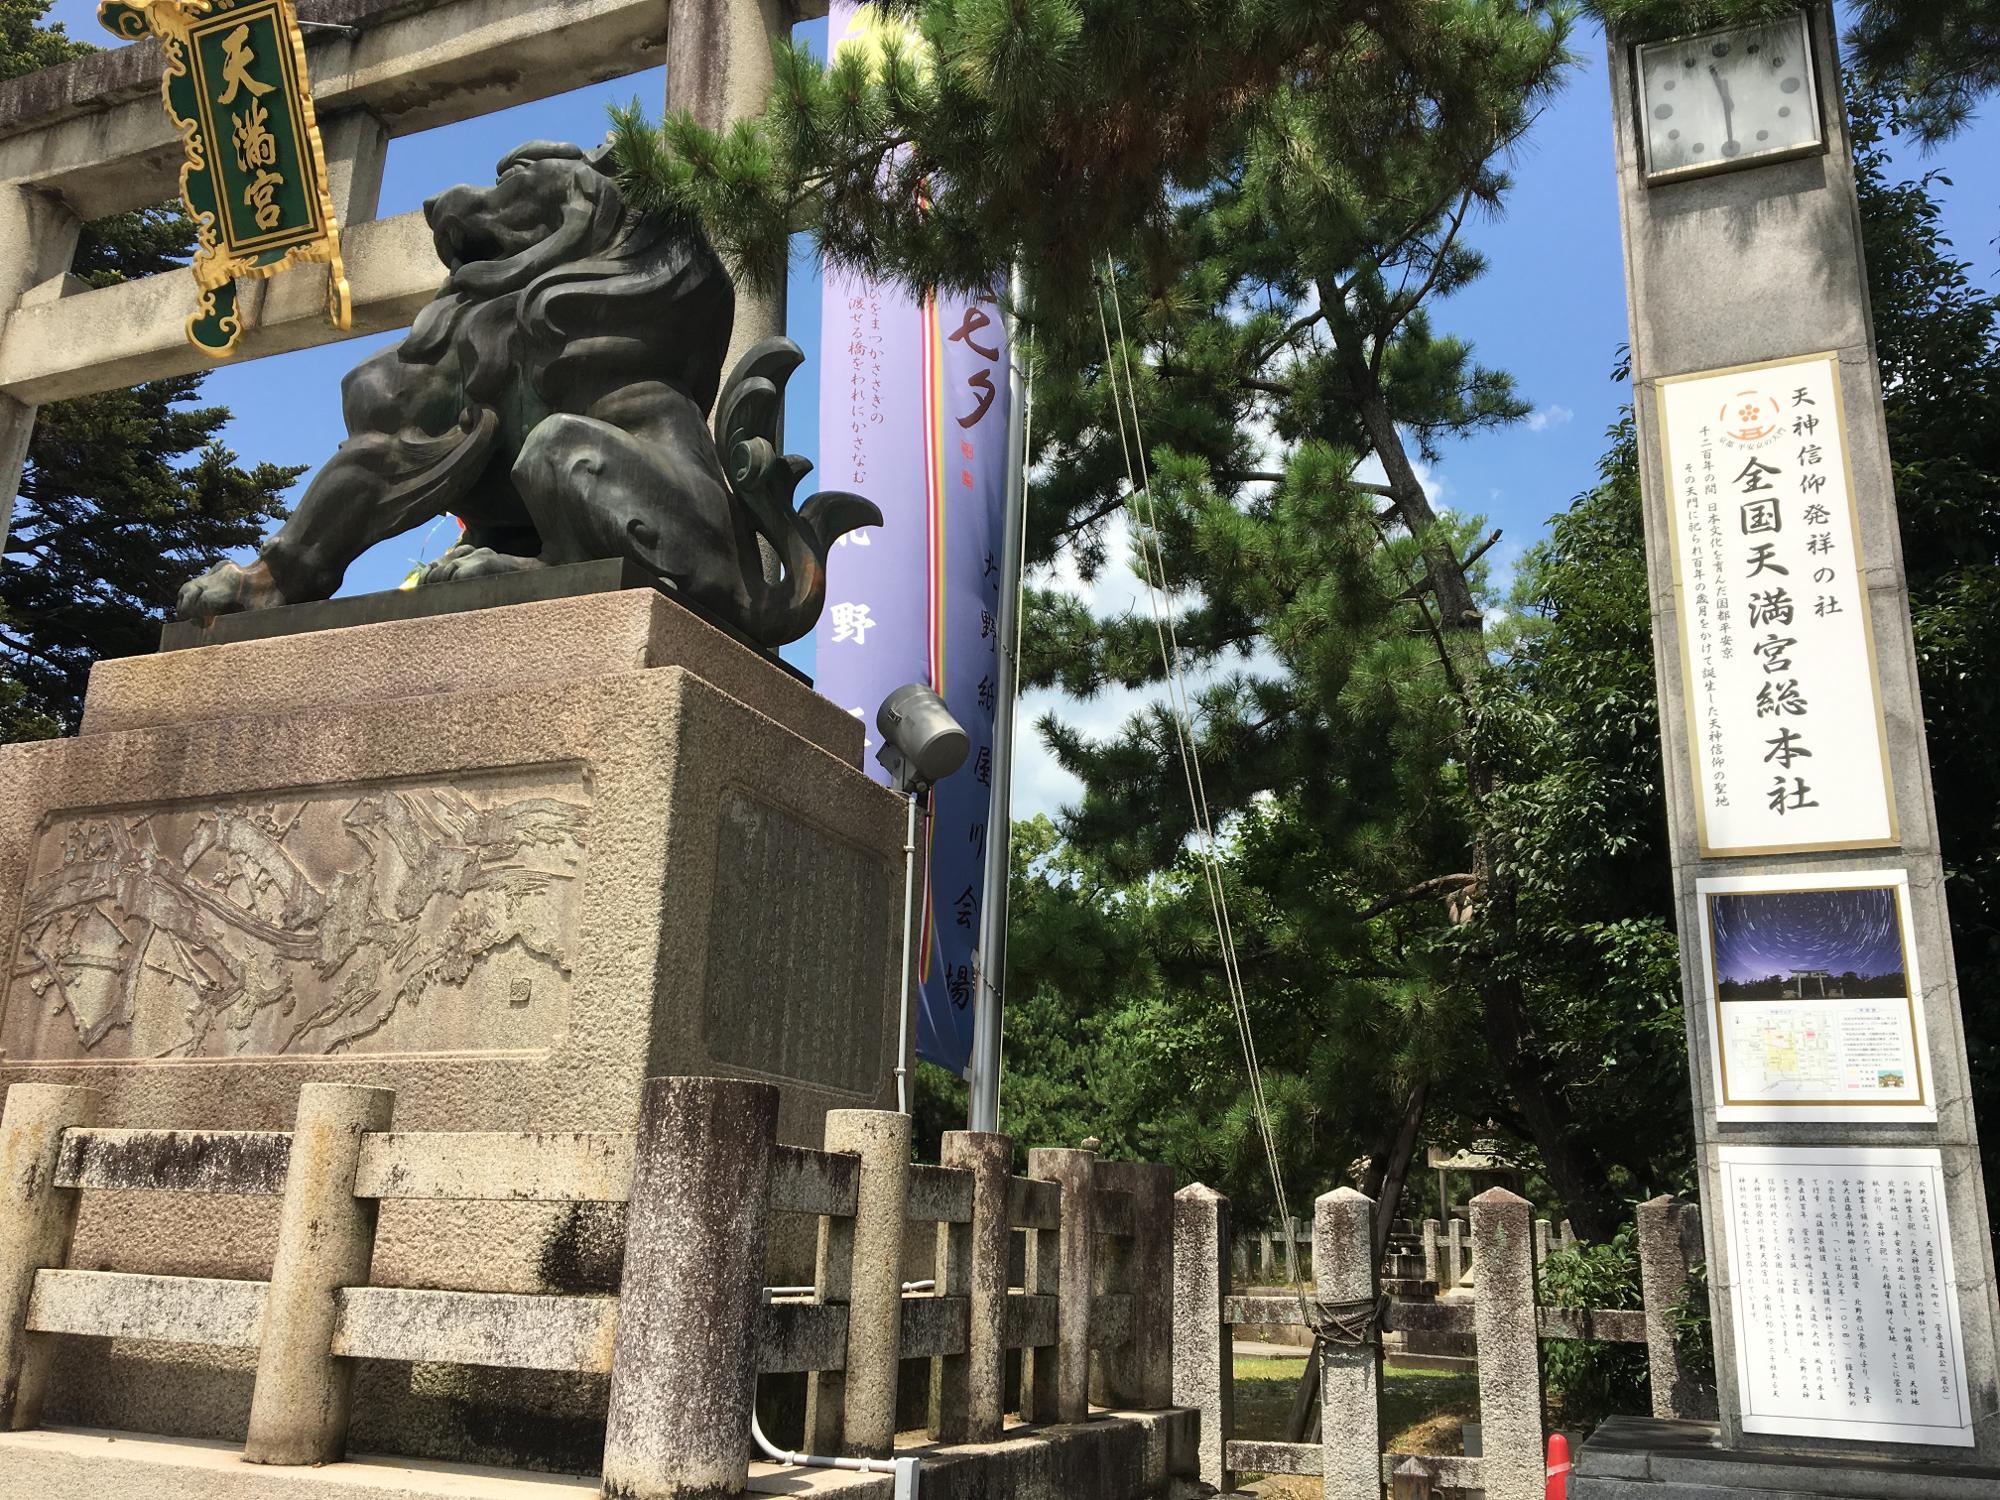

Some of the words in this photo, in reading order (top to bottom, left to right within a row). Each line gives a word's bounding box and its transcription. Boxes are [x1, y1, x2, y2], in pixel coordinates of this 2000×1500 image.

[217, 23, 285, 231] 天満宮
[847, 295, 868, 485] 渡せる橋をわれにかさなむ
[1791, 387, 1843, 618] 天神信仰発祥の社
[1732, 456, 1820, 816] 全国天満宮総本社
